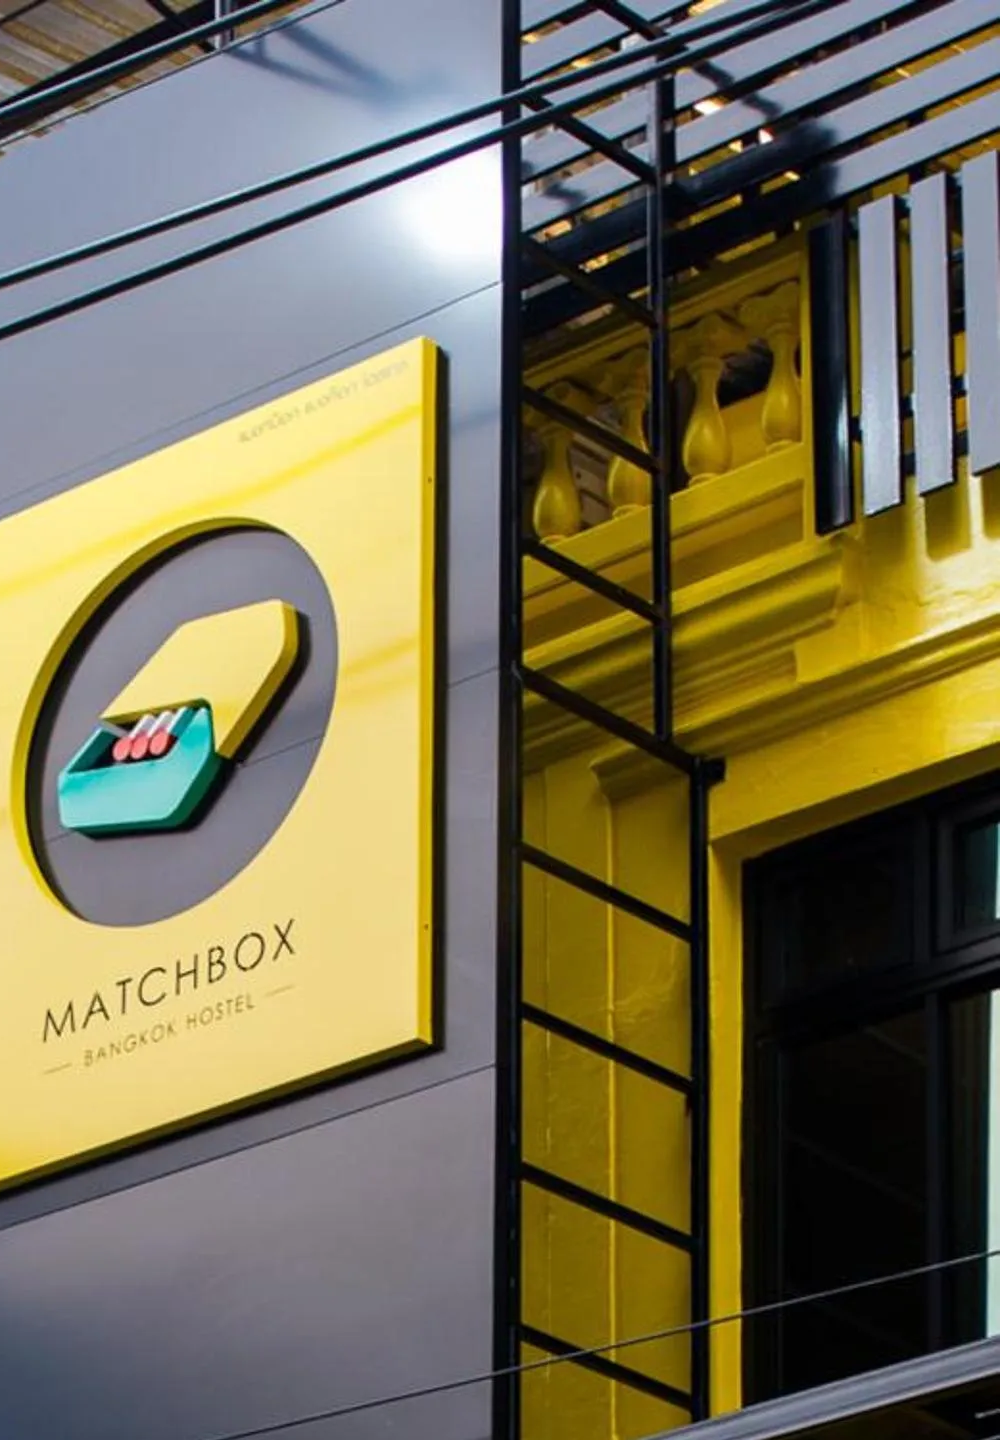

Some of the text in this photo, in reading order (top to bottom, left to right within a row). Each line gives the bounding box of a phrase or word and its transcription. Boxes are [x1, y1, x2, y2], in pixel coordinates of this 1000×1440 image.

[42, 918, 296, 1043] MATCHBOX
[83, 993, 256, 1067] BANGKOK HOSTEL
